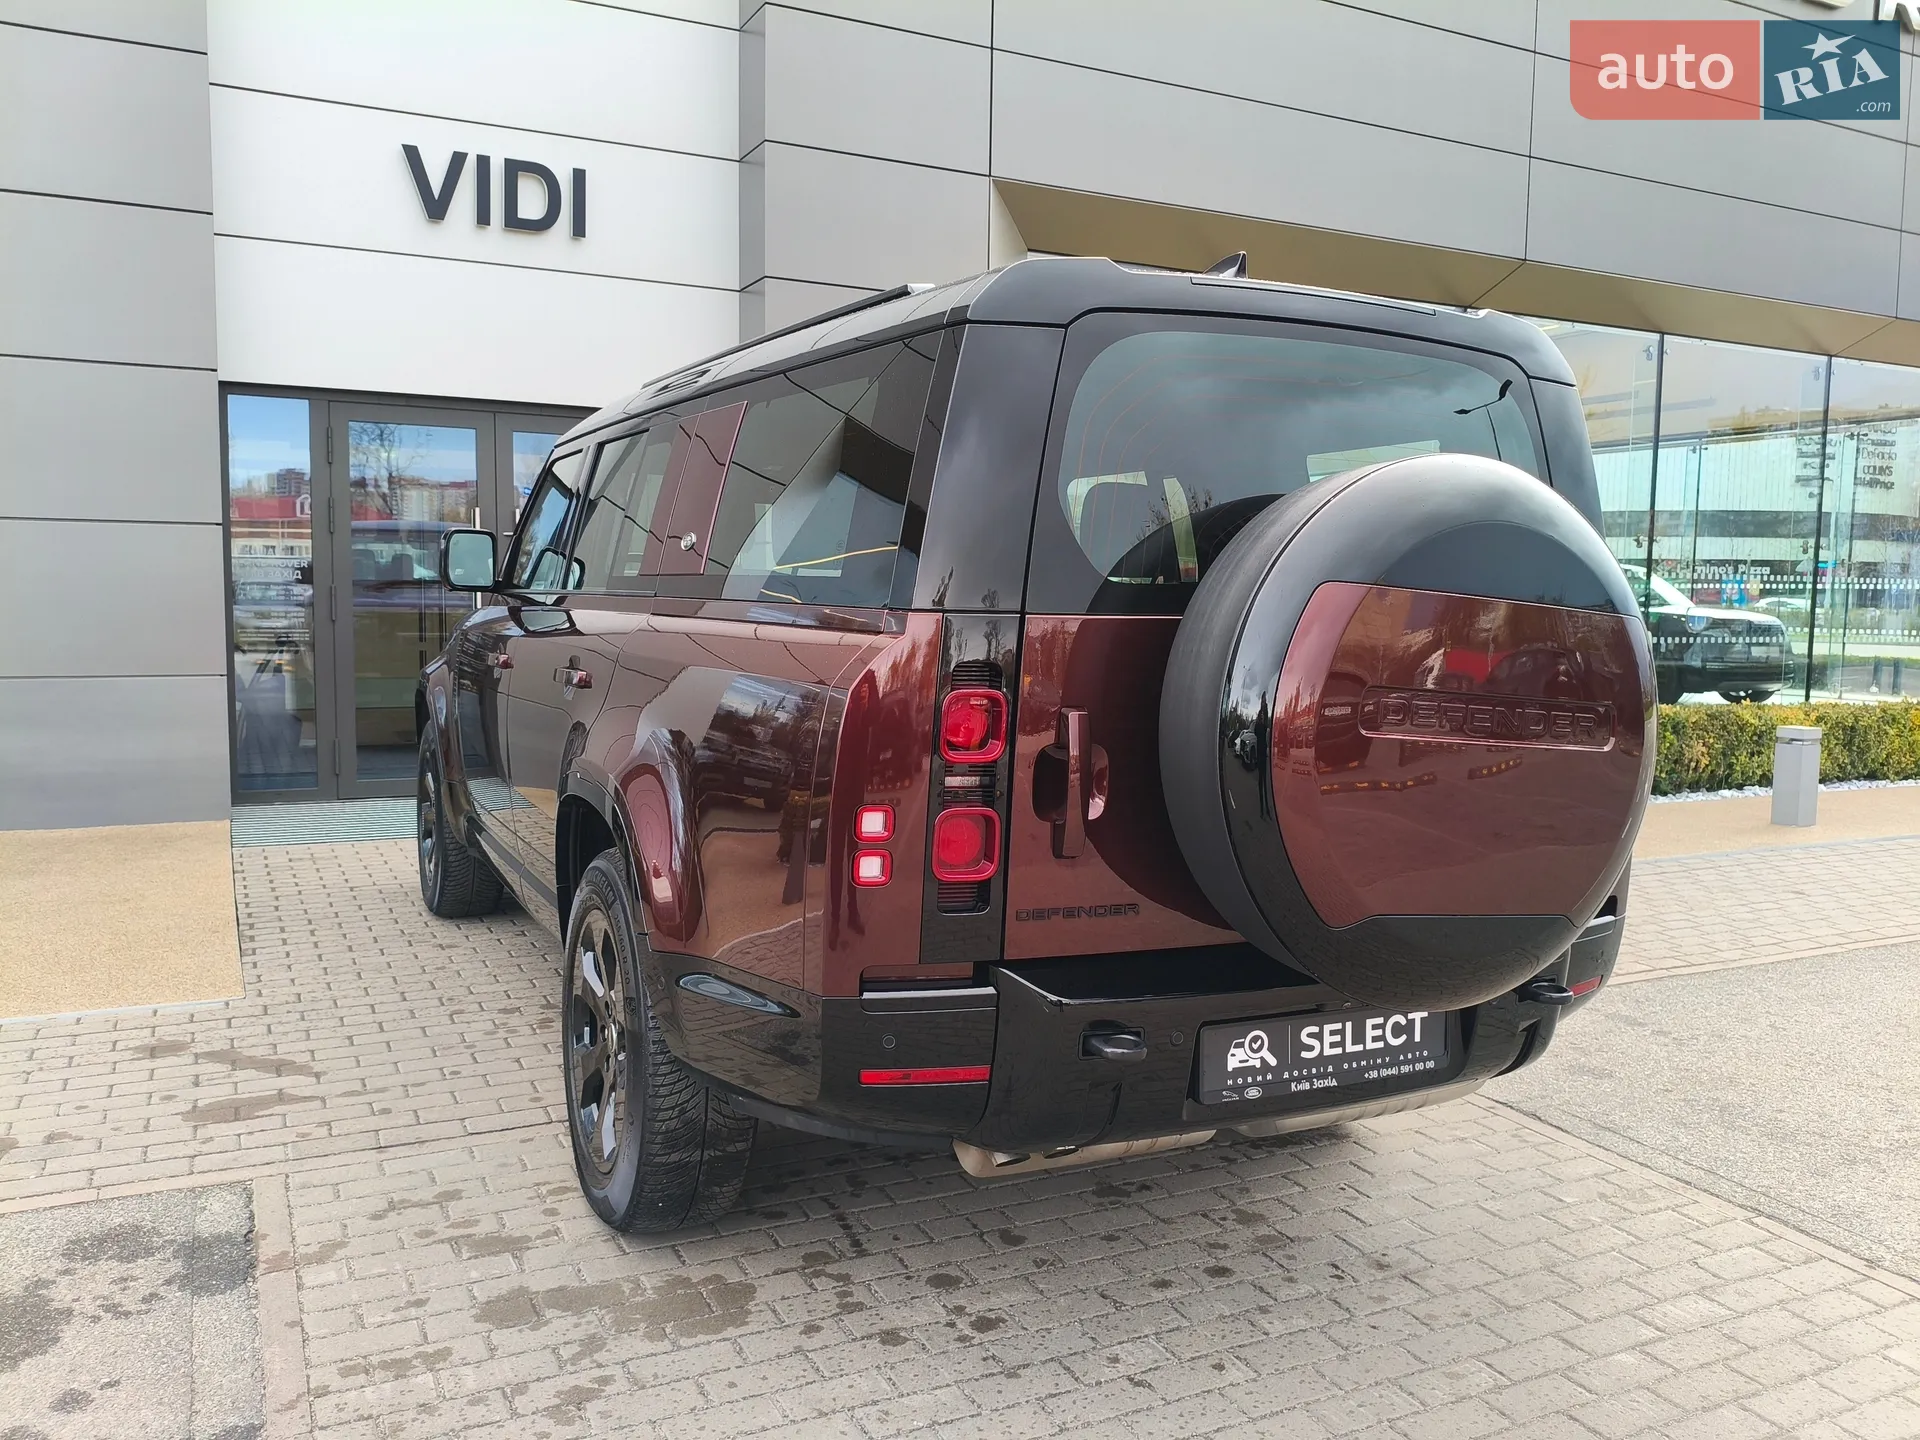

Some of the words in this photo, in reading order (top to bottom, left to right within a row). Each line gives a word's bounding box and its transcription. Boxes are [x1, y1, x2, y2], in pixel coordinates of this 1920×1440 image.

[401, 143, 587, 239] VIDI
[1377, 697, 1600, 740] DEFENDER
[1015, 903, 1140, 922] DEFENDER
[1300, 1011, 1428, 1059] SELECT
[1227, 1072, 1272, 1086] НОВИЙ
[1283, 1065, 1334, 1079] ДОСВІД
[1343, 1056, 1390, 1070] ОБМІНУ
[1399, 1050, 1428, 1060] АВТО
[1291, 1080, 1310, 1092] Київ
[1312, 1076, 1338, 1089] Захід
[1364, 1070, 1378, 1079] +38
[1380, 1066, 1398, 1077] (044)
[1400, 1063, 1413, 1073] 591
[1415, 1061, 1424, 1071] 00
[1425, 1060, 1435, 1068] 00
